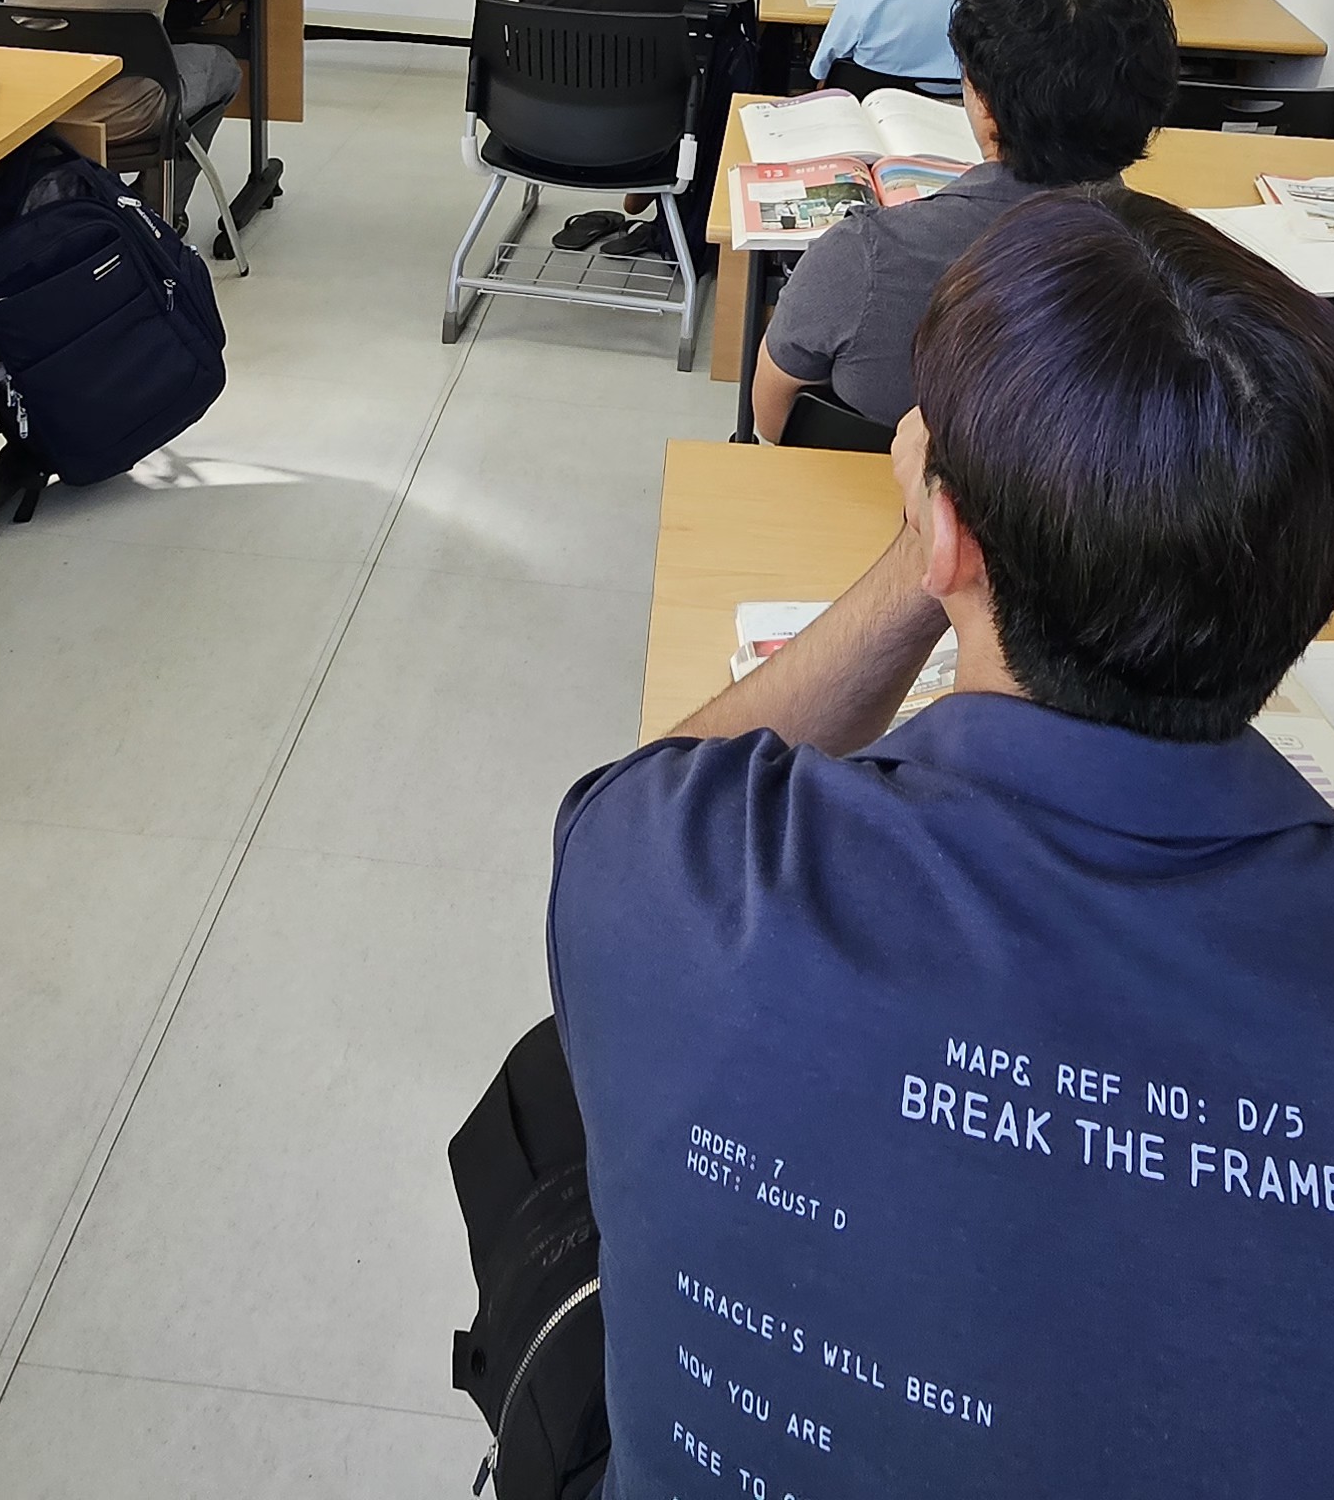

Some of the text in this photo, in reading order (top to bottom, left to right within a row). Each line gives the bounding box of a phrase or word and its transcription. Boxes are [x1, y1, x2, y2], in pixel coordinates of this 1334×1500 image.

[901, 1074, 1051, 1155] BREAK
[1075, 1119, 1165, 1181] THE
[946, 1037, 1304, 1138] MAP& REF NO: D/5
[687, 1149, 846, 1230] HOST: AGUST D
[691, 1124, 784, 1179] ORDER: 7
[678, 1271, 992, 1427] MIRACLE'S WILL BEGIN
[679, 1345, 832, 1452] NOW YOU ARE
[673, 1421, 766, 1500] FREE TO
